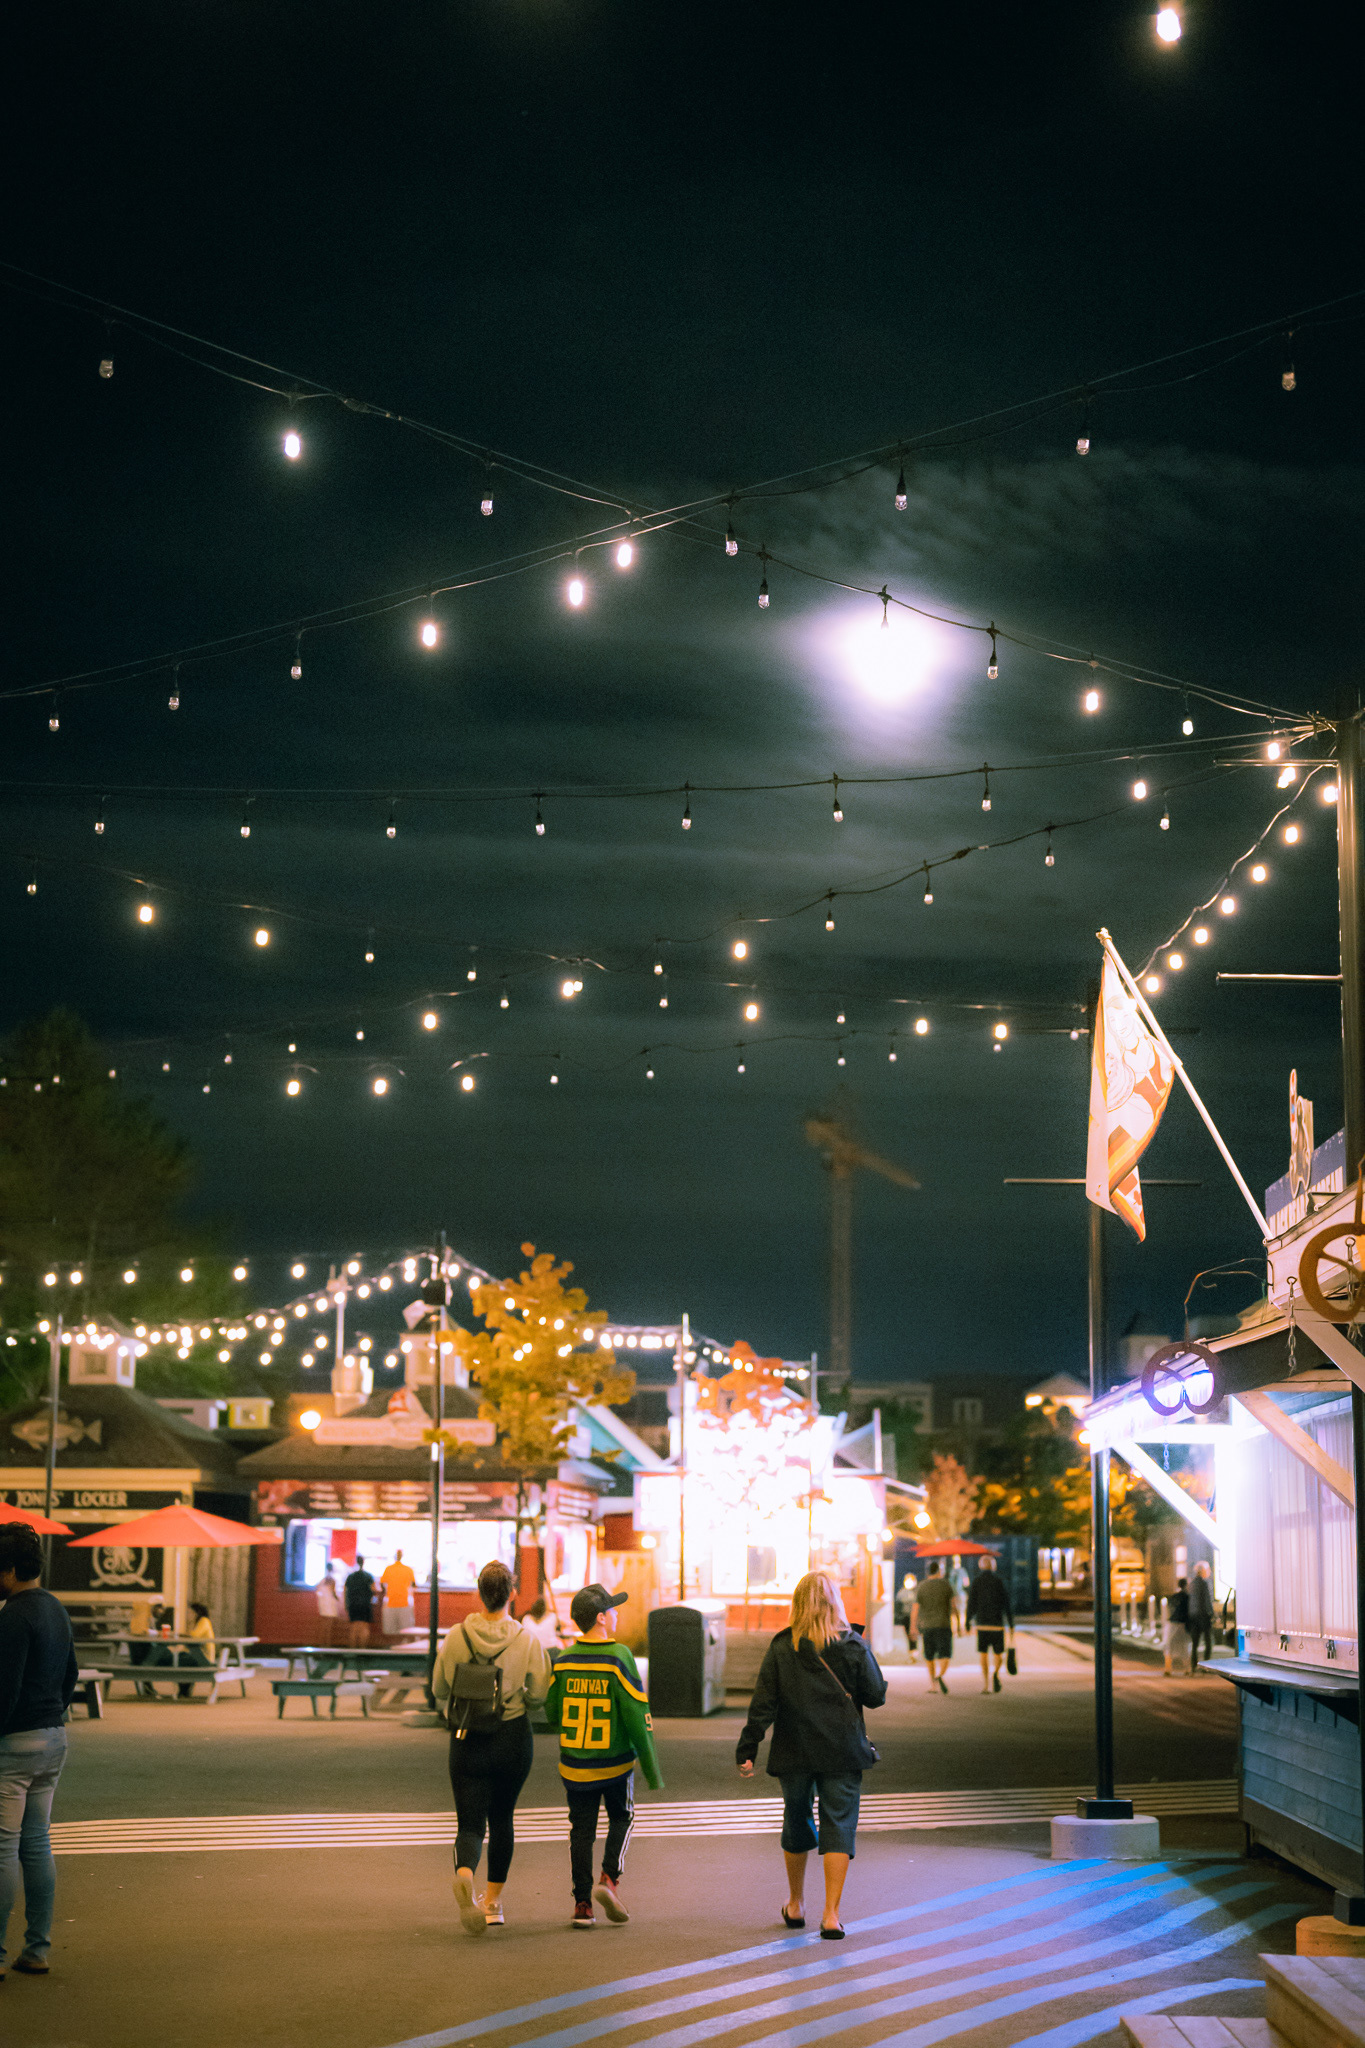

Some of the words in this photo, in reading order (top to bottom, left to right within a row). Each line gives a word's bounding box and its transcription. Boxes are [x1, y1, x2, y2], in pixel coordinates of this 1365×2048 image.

[16, 1490, 64, 1508] JONS'
[73, 1491, 128, 1507] LOCKER
[566, 1678, 609, 1694] CONWAY
[560, 1697, 611, 1749] 96
